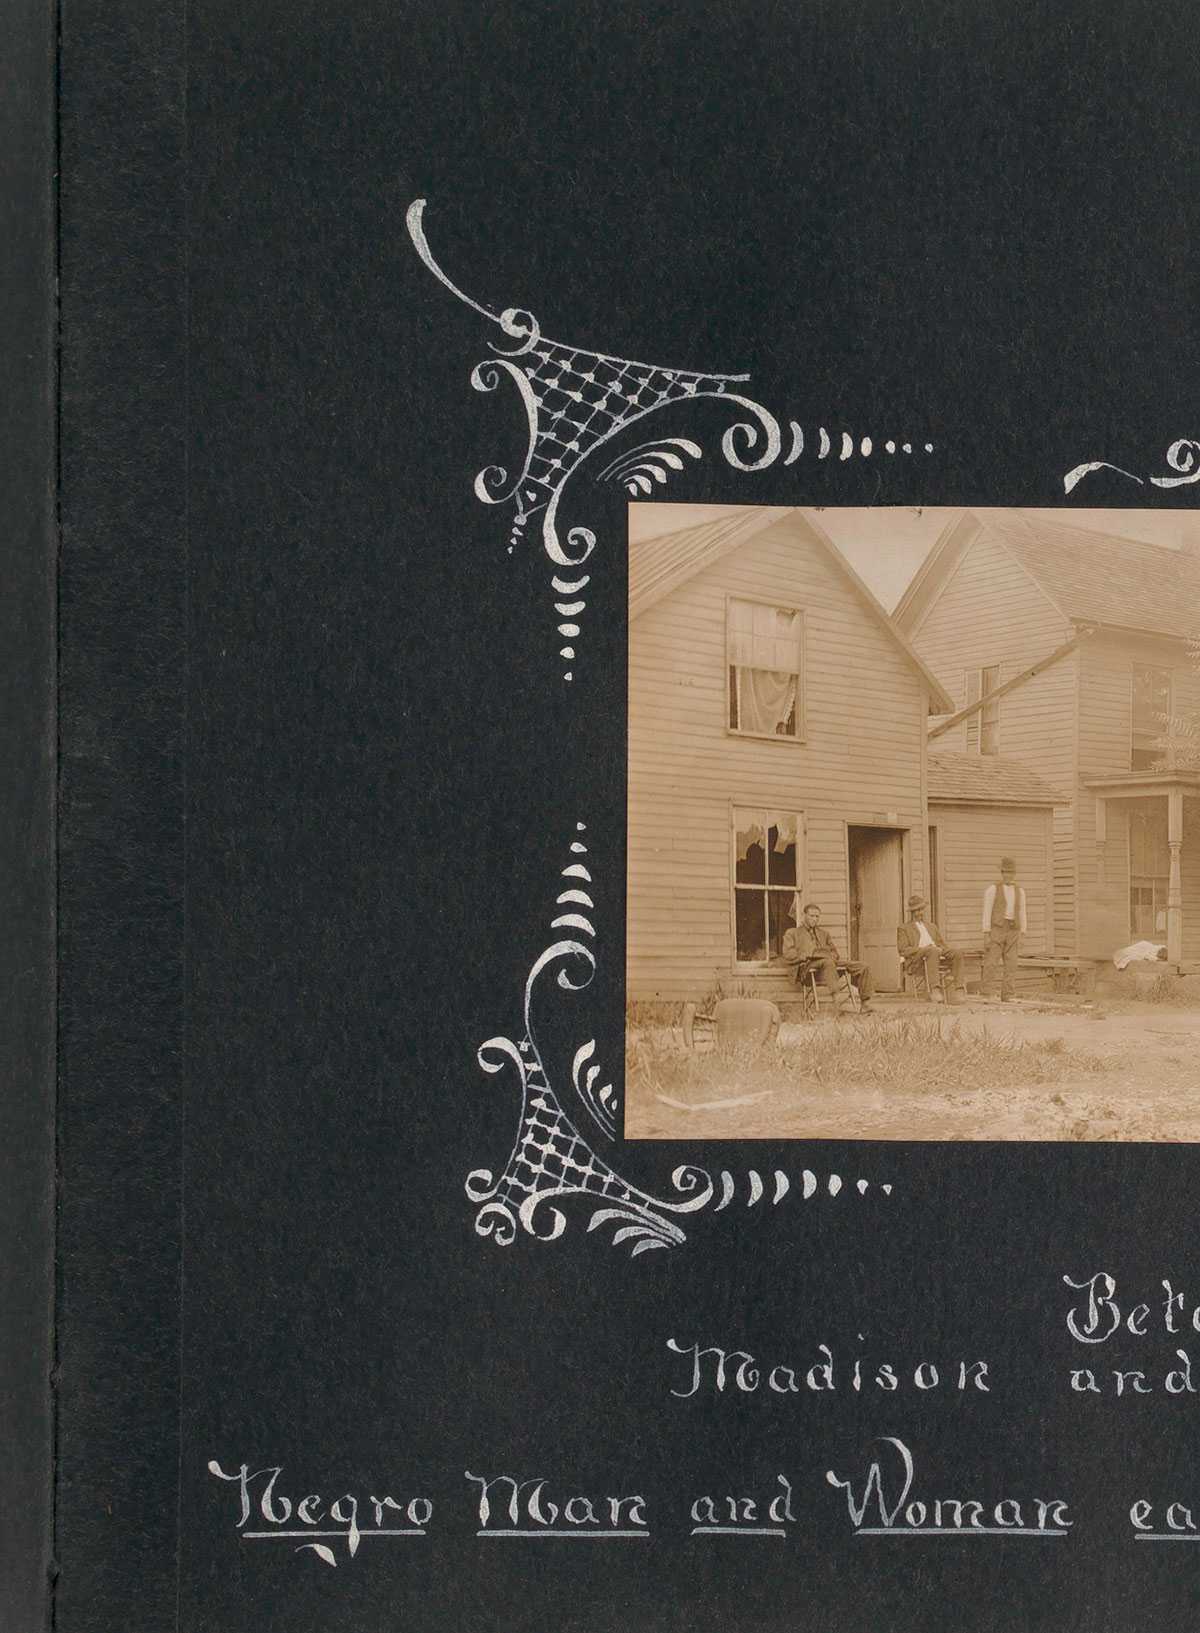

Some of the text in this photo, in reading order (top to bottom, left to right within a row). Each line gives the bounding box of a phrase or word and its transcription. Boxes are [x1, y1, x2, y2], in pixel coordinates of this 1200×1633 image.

[666, 1335, 991, 1398] Madison
[1070, 1348, 1198, 1397] and
[208, 1459, 433, 1567] Negro
[464, 1470, 647, 1529] Man
[690, 1473, 797, 1525] and
[826, 1436, 1074, 1532] Woman
